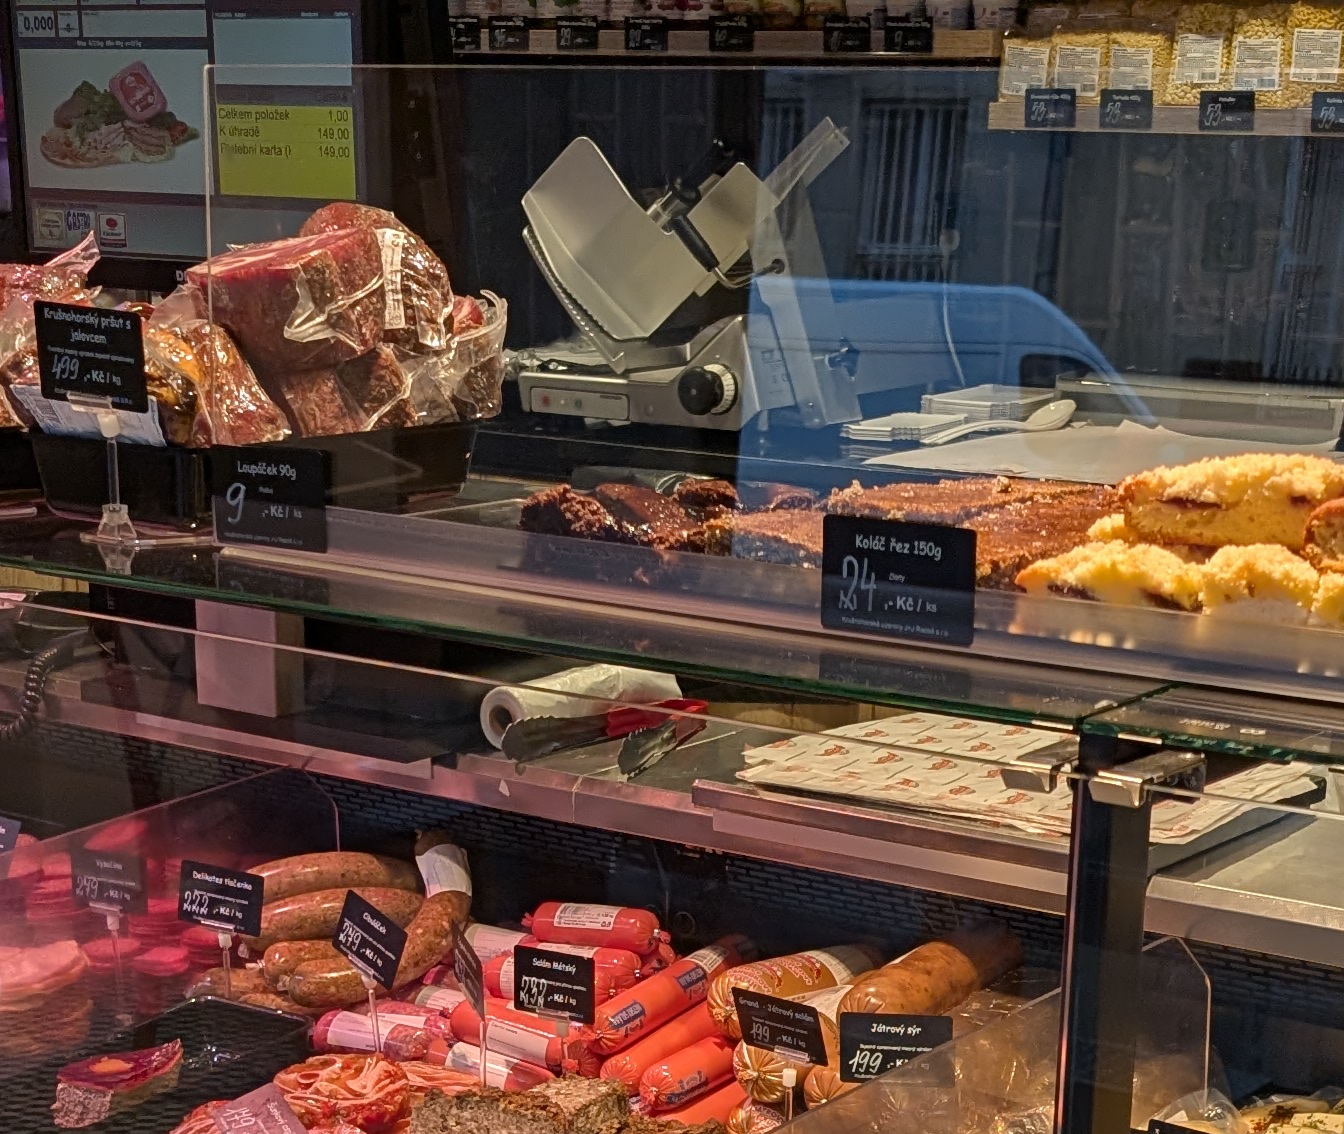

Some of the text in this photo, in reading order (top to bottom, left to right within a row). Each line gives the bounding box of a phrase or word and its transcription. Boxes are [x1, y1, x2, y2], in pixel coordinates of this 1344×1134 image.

[218, 109, 252, 121] Celkem
[328, 109, 350, 122] 1,00
[317, 127, 350, 141] 149,00
[318, 146, 351, 159] 149,00
[855, 533, 886, 551] Koláč
[913, 540, 942, 562] 150g
[896, 595, 914, 612] Kč
[871, 1023, 922, 1037] Játrový sýr
[848, 1050, 883, 1074] 199
